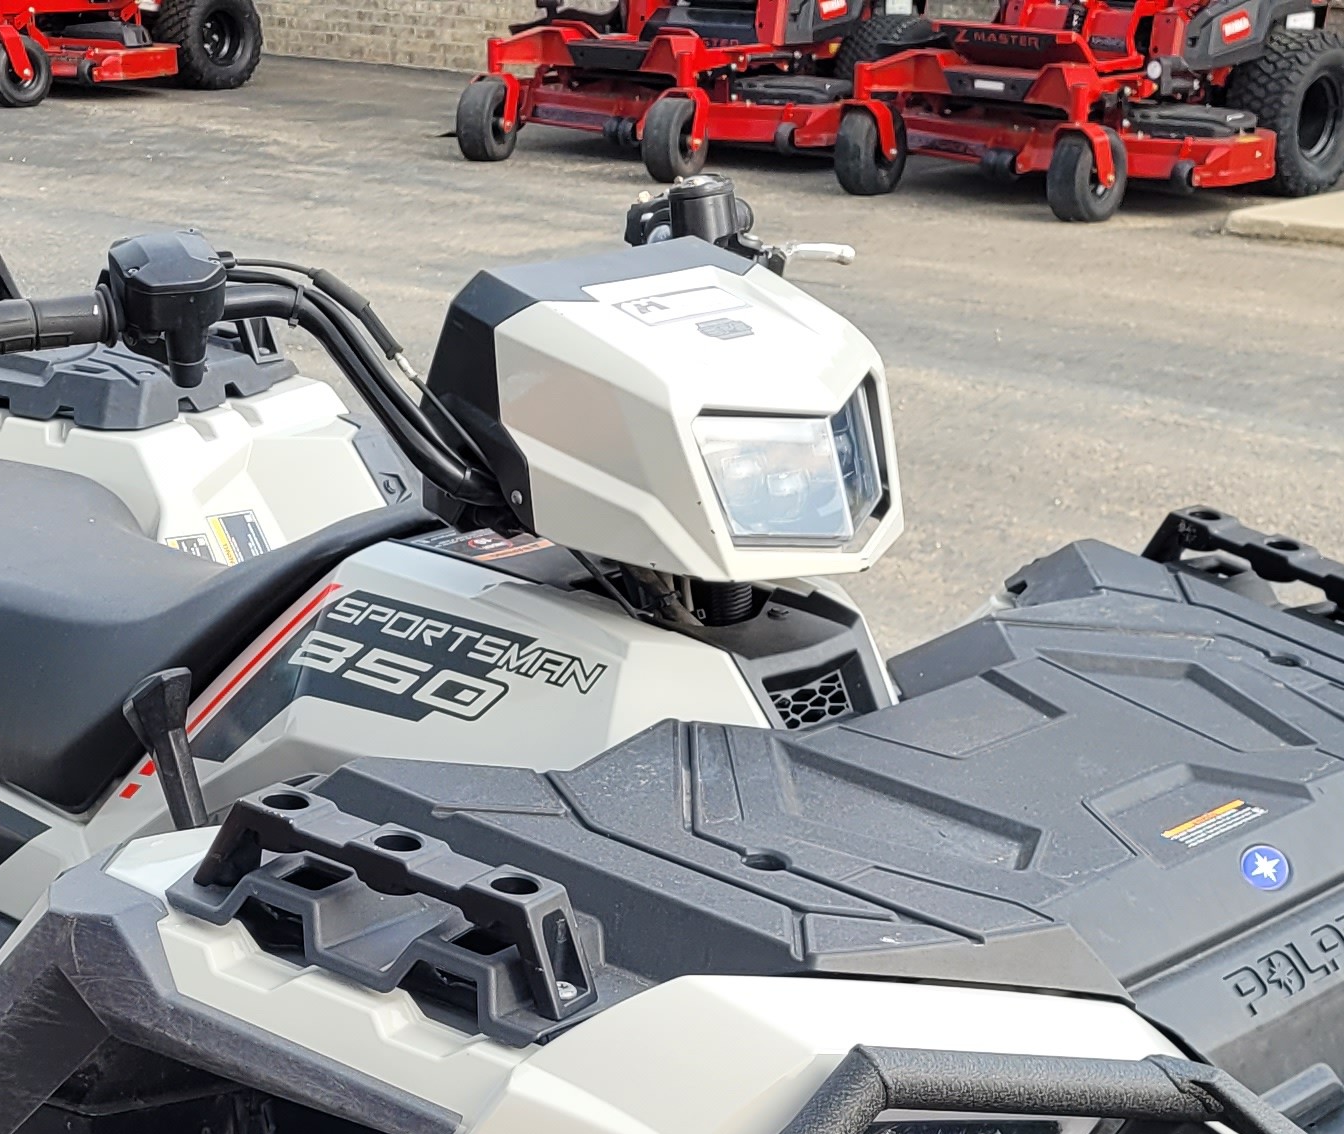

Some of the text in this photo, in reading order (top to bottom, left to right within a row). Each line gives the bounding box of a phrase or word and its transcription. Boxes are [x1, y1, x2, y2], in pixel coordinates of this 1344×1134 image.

[973, 31, 1040, 50] MASTER
[287, 631, 509, 722] 850
[327, 598, 608, 694] SPORTSMAN
